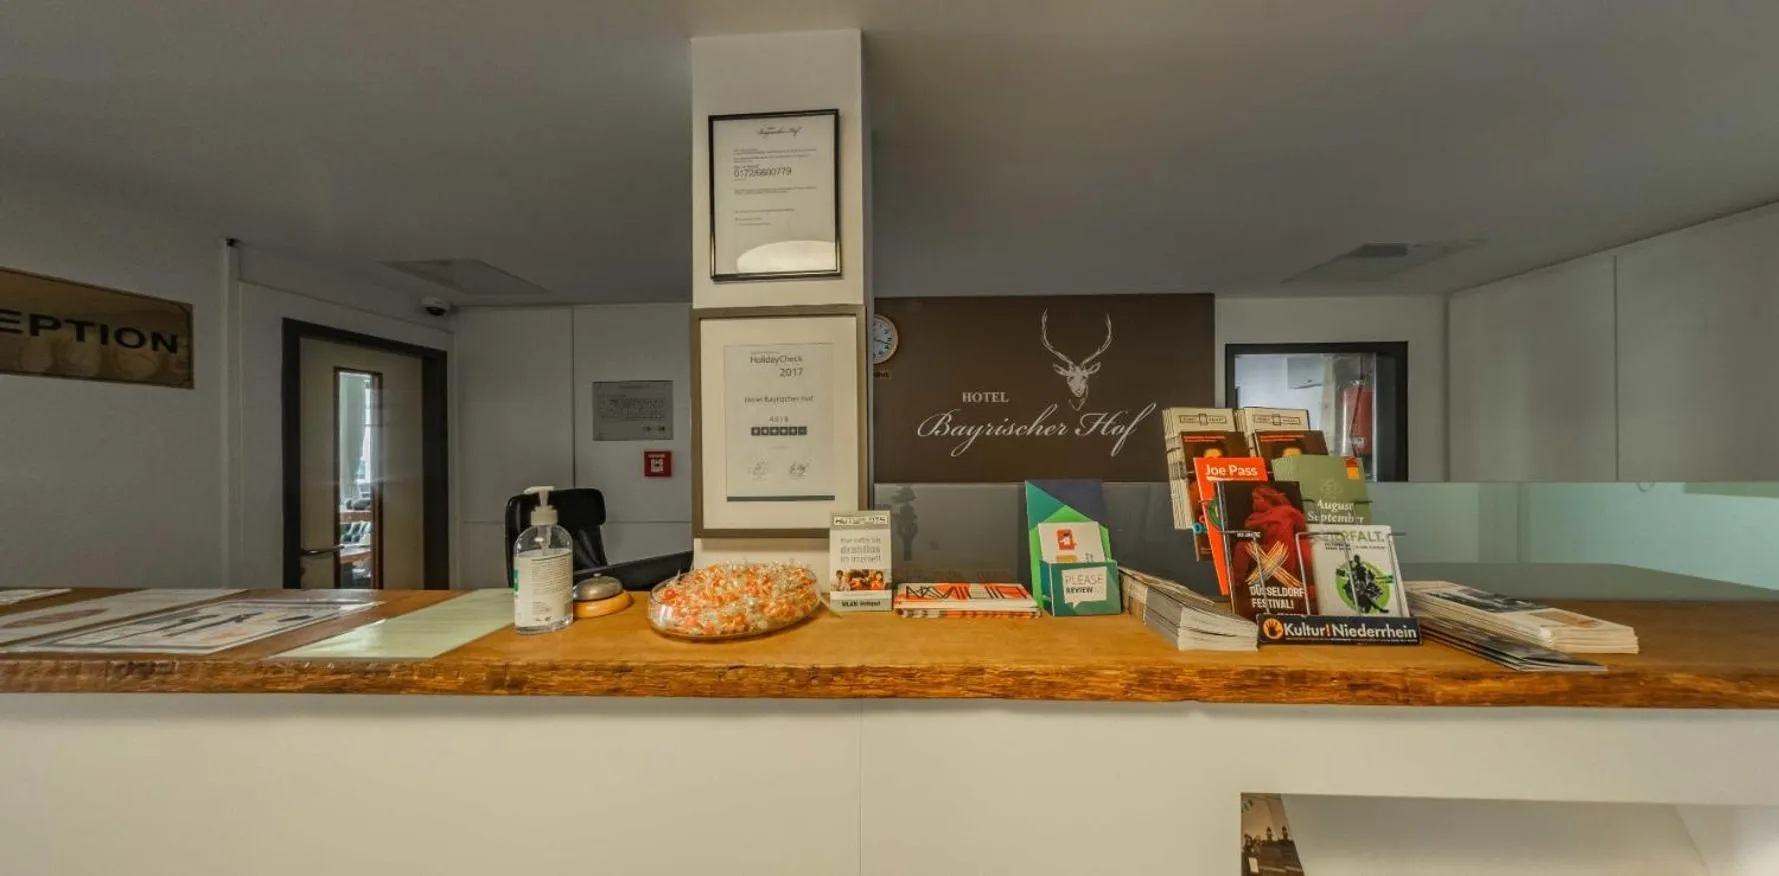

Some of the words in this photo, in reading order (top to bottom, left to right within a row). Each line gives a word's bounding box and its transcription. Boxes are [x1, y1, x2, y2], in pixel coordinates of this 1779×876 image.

[779, 367, 804, 378] 2017
[962, 391, 1009, 404] HOTEL
[917, 404, 1069, 457] Bayrischer
[1075, 402, 1156, 457] Hof
[1205, 464, 1226, 476] Joe
[1229, 464, 1258, 477] Pass
[1317, 500, 1355, 513] August
[1064, 574, 1104, 585] PLEASE
[1065, 586, 1093, 594] REVIEW
